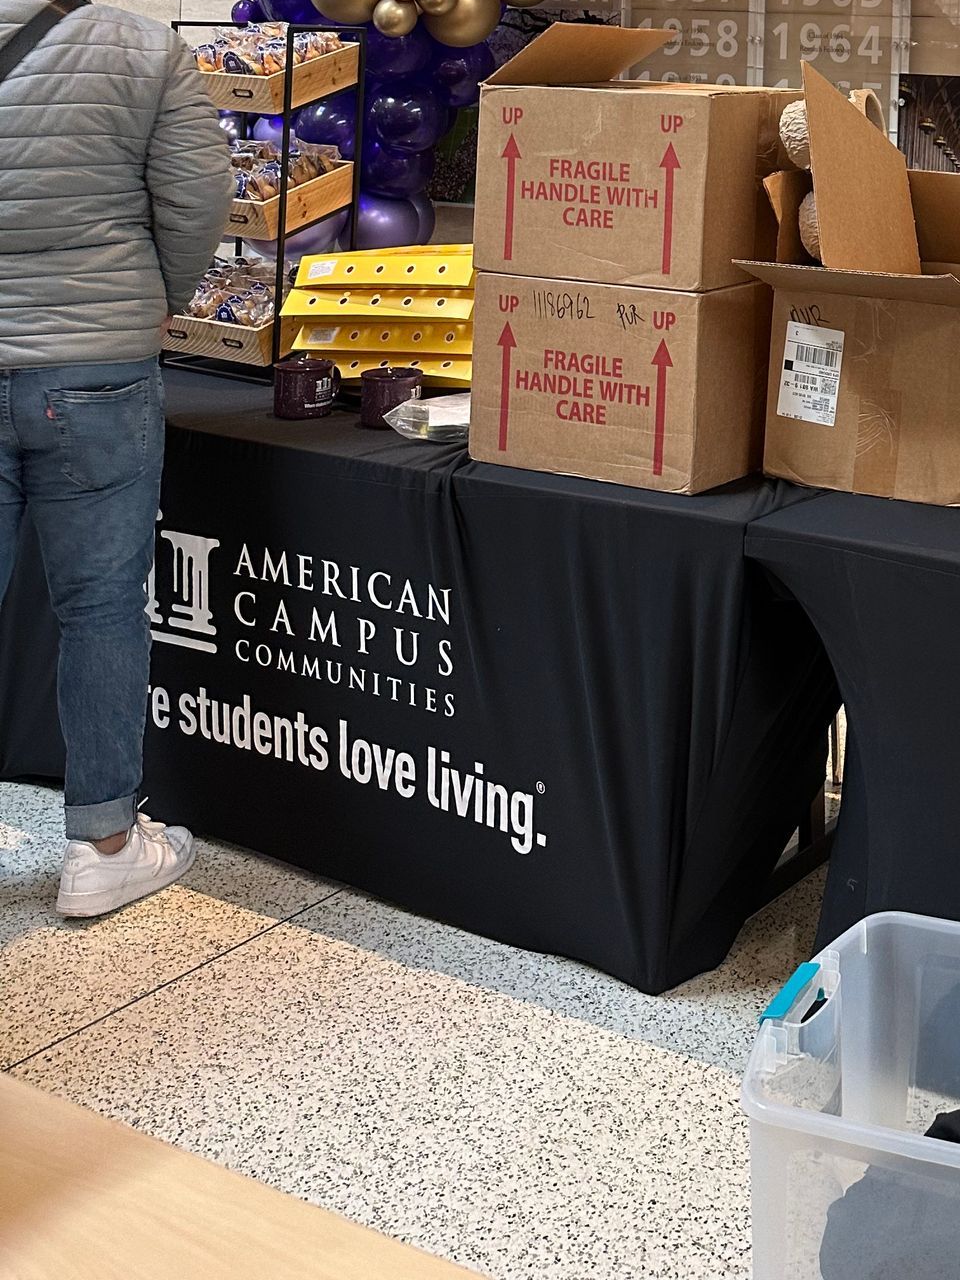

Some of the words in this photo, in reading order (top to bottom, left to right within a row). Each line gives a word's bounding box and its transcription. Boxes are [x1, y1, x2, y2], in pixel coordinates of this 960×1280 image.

[772, 22, 883, 65] 1964
[502, 106, 523, 126] UP
[660, 114, 684, 134] UP
[549, 158, 631, 183] FRAGILE
[521, 180, 601, 205] HANDLE
[606, 186, 659, 209] WITH
[562, 206, 614, 229] CARE
[499, 294, 519, 313] UP
[653, 311, 676, 331] UP
[543, 349, 624, 379] FRAGILE
[515, 370, 594, 400] HANDLE
[599, 380, 651, 408] WITH
[556, 399, 607, 426] CARE
[233, 543, 452, 626] AMERICAN
[234, 590, 454, 677] CAMPUS
[235, 639, 456, 718] COMMUNITIES
[178, 686, 329, 772] students
[338, 718, 417, 799] love
